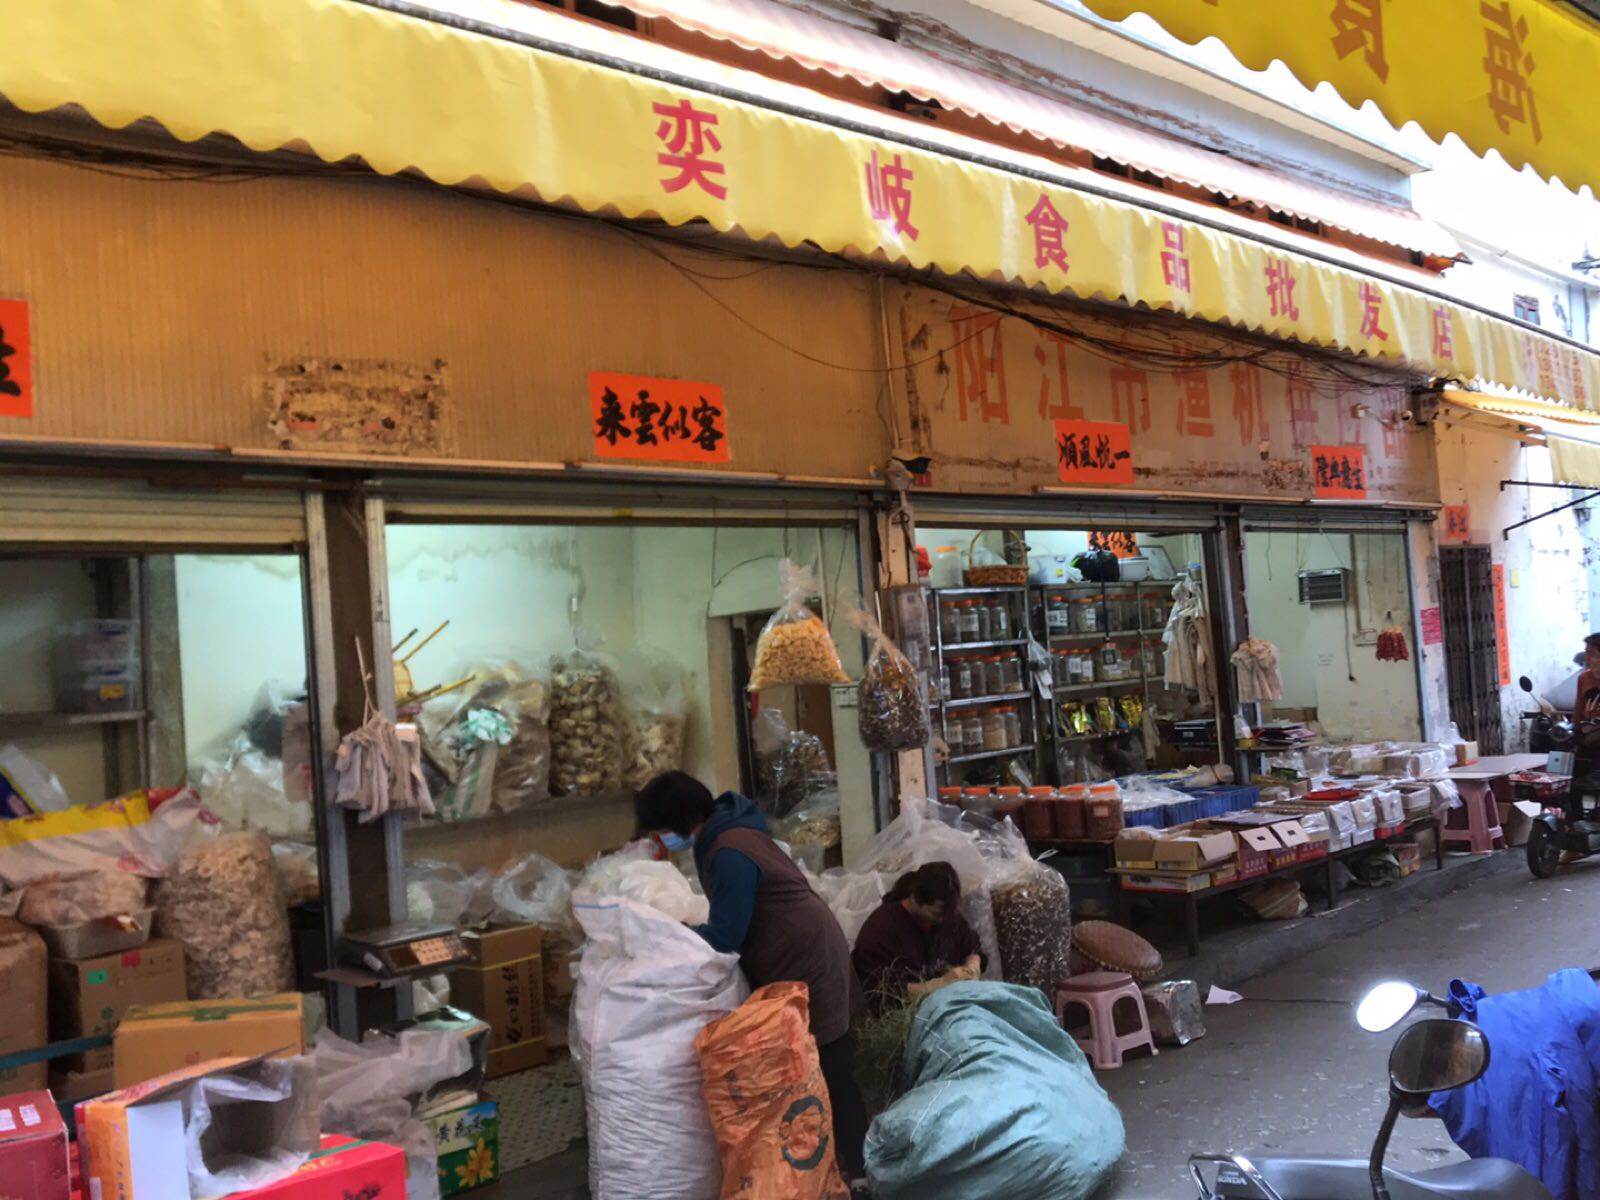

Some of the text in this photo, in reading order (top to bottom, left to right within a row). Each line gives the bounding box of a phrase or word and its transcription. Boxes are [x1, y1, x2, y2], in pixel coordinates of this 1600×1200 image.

[652, 99, 1454, 360] 奕岐食品批发店
